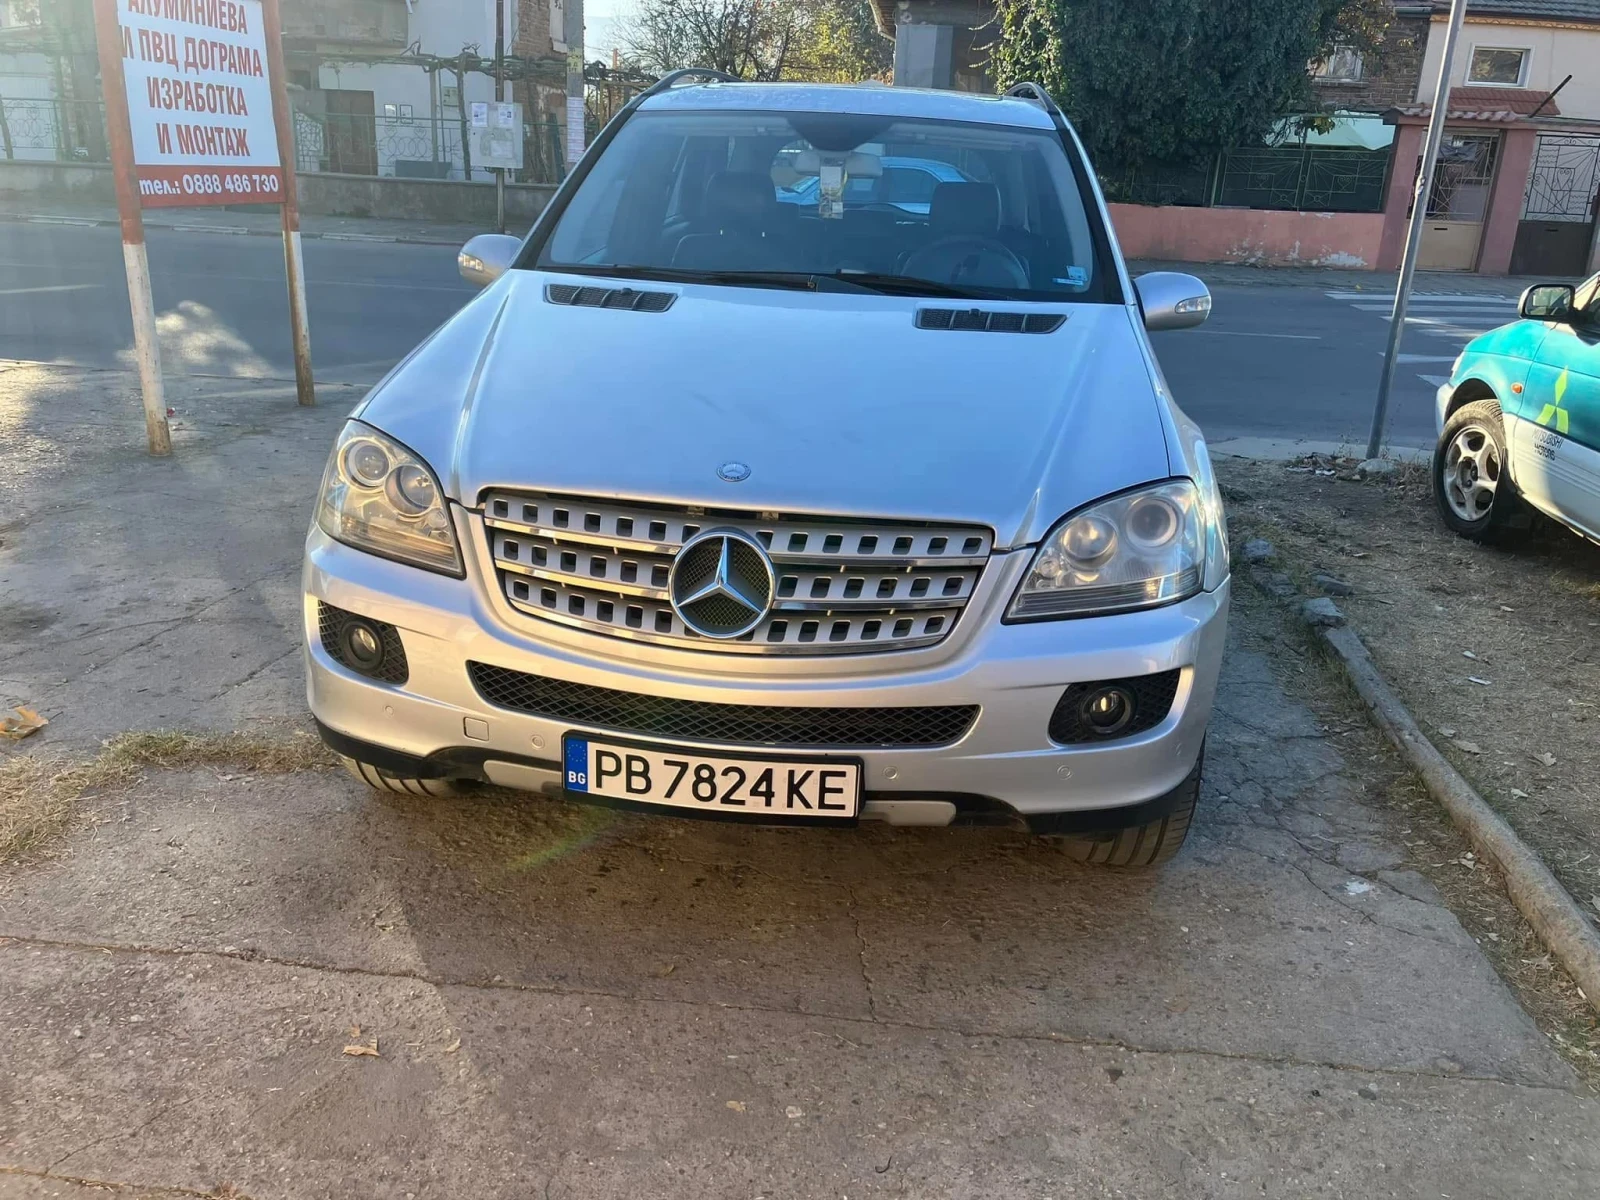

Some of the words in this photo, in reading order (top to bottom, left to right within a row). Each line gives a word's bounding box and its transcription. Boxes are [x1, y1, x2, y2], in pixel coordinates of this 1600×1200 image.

[121, 25, 134, 59] И
[138, 28, 179, 73] ПВЦ
[184, 36, 264, 77] ДОГРАМА
[147, 76, 248, 116] ИЗРАБОТКА
[156, 122, 173, 154] И
[176, 124, 250, 156] МОНТАЖ
[183, 174, 222, 194] 0888
[225, 175, 251, 193] 486
[253, 174, 279, 192] 730
[568, 771, 586, 784] BG
[595, 749, 651, 794] PB
[663, 759, 775, 807] 7824
[786, 769, 847, 810] KE
